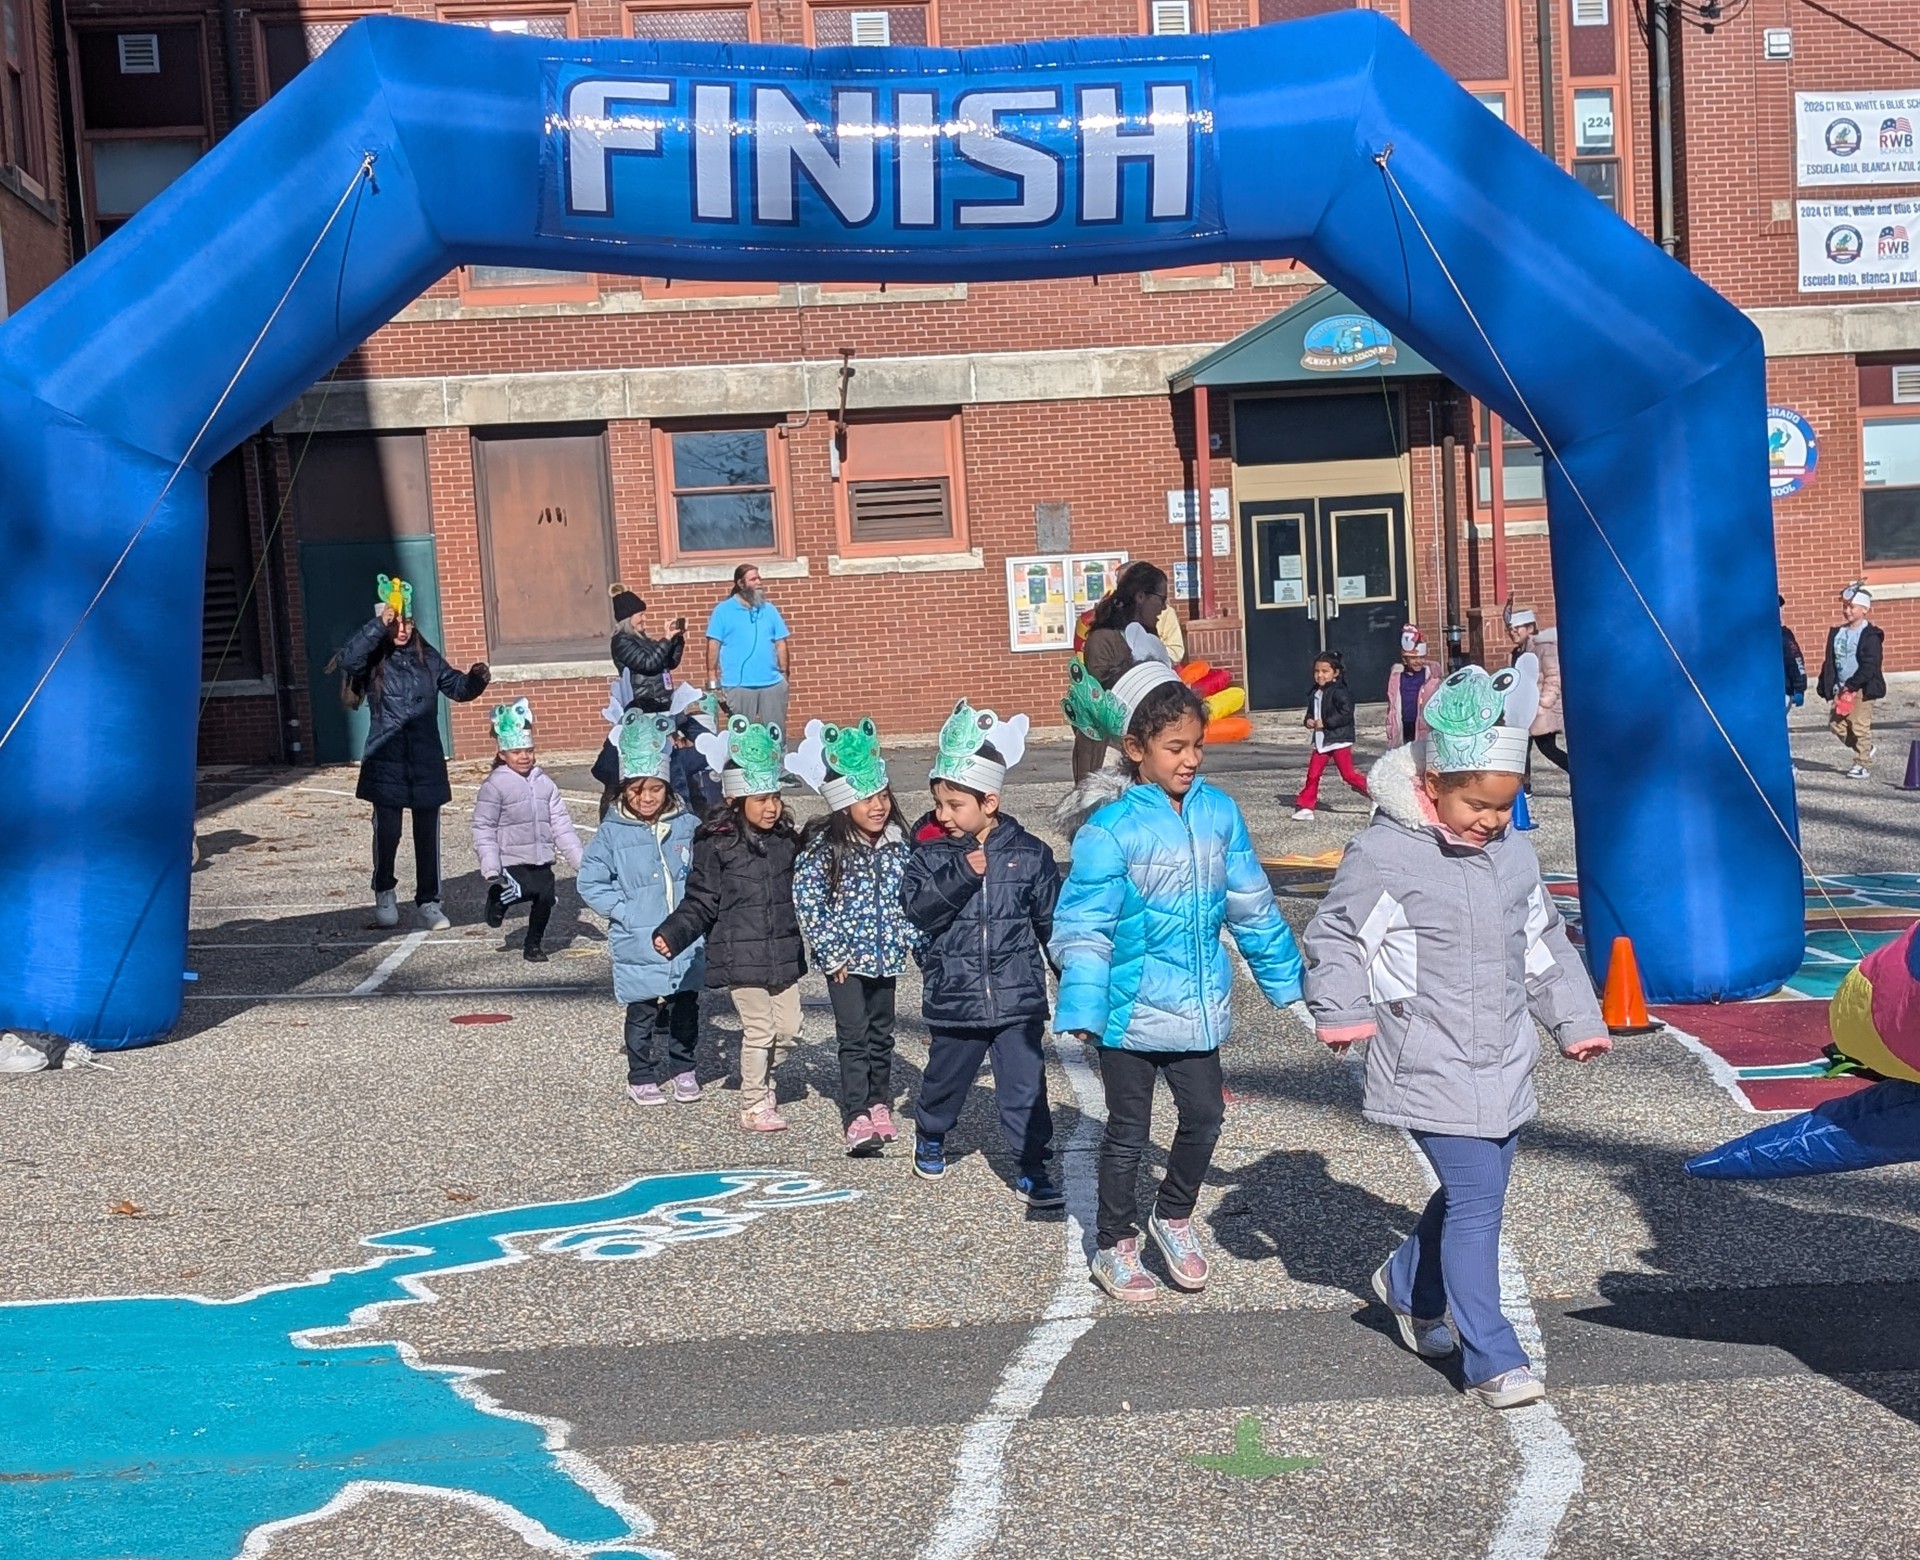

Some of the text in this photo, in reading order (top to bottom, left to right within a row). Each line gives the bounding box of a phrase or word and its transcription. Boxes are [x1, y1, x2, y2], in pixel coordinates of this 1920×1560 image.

[1804, 102, 1825, 112] 2025
[1825, 101, 1835, 111] CT
[1836, 101, 1854, 111] RED,
[1855, 100, 1878, 110] WHITE
[1886, 99, 1906, 109] BLUE
[1588, 117, 1611, 128] 224
[1879, 134, 1913, 147] RWB
[564, 76, 1194, 229] FINISH
[1806, 164, 1839, 174] ESCUELA
[1840, 163, 1860, 174] ROJA,
[1861, 162, 1891, 173] BLANCA
[1891, 161, 1897, 172] Y
[1898, 161, 1916, 172] AZUL
[1801, 206, 1821, 217] 2024
[1823, 206, 1832, 216] CT
[1893, 202, 1911, 214] Blue
[1878, 241, 1909, 254] RWB
[1803, 269, 1917, 286] Escuela Roja, Blanca y Azul
[1338, 355, 1354, 364] NEW
